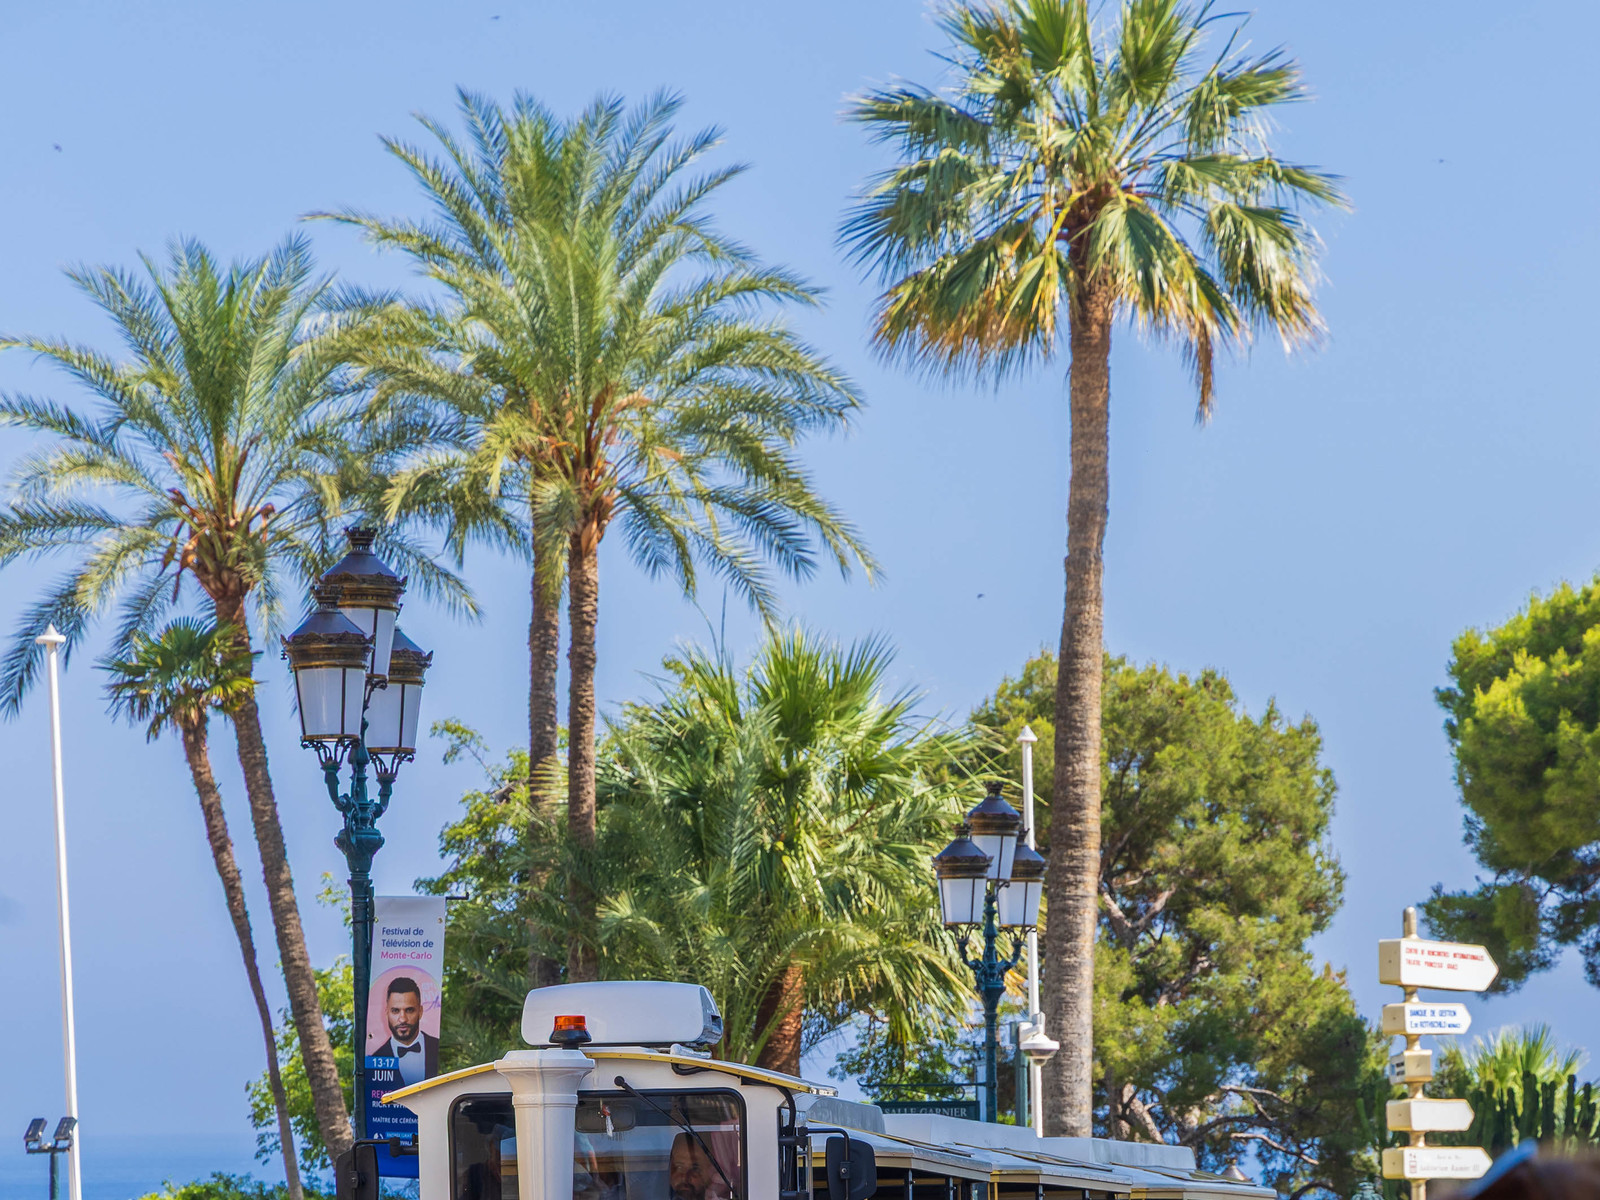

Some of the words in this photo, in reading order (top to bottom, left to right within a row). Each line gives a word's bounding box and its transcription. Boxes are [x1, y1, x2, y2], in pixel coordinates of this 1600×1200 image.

[382, 927, 411, 935] Festival
[412, 927, 424, 935] de
[382, 938, 421, 947] Télévision
[423, 939, 434, 947] de
[380, 951, 432, 960] Monte-Carlo
[372, 1058, 395, 1068] 13-17
[372, 1070, 394, 1082] JUIN
[920, 1107, 967, 1117] GARNIER
